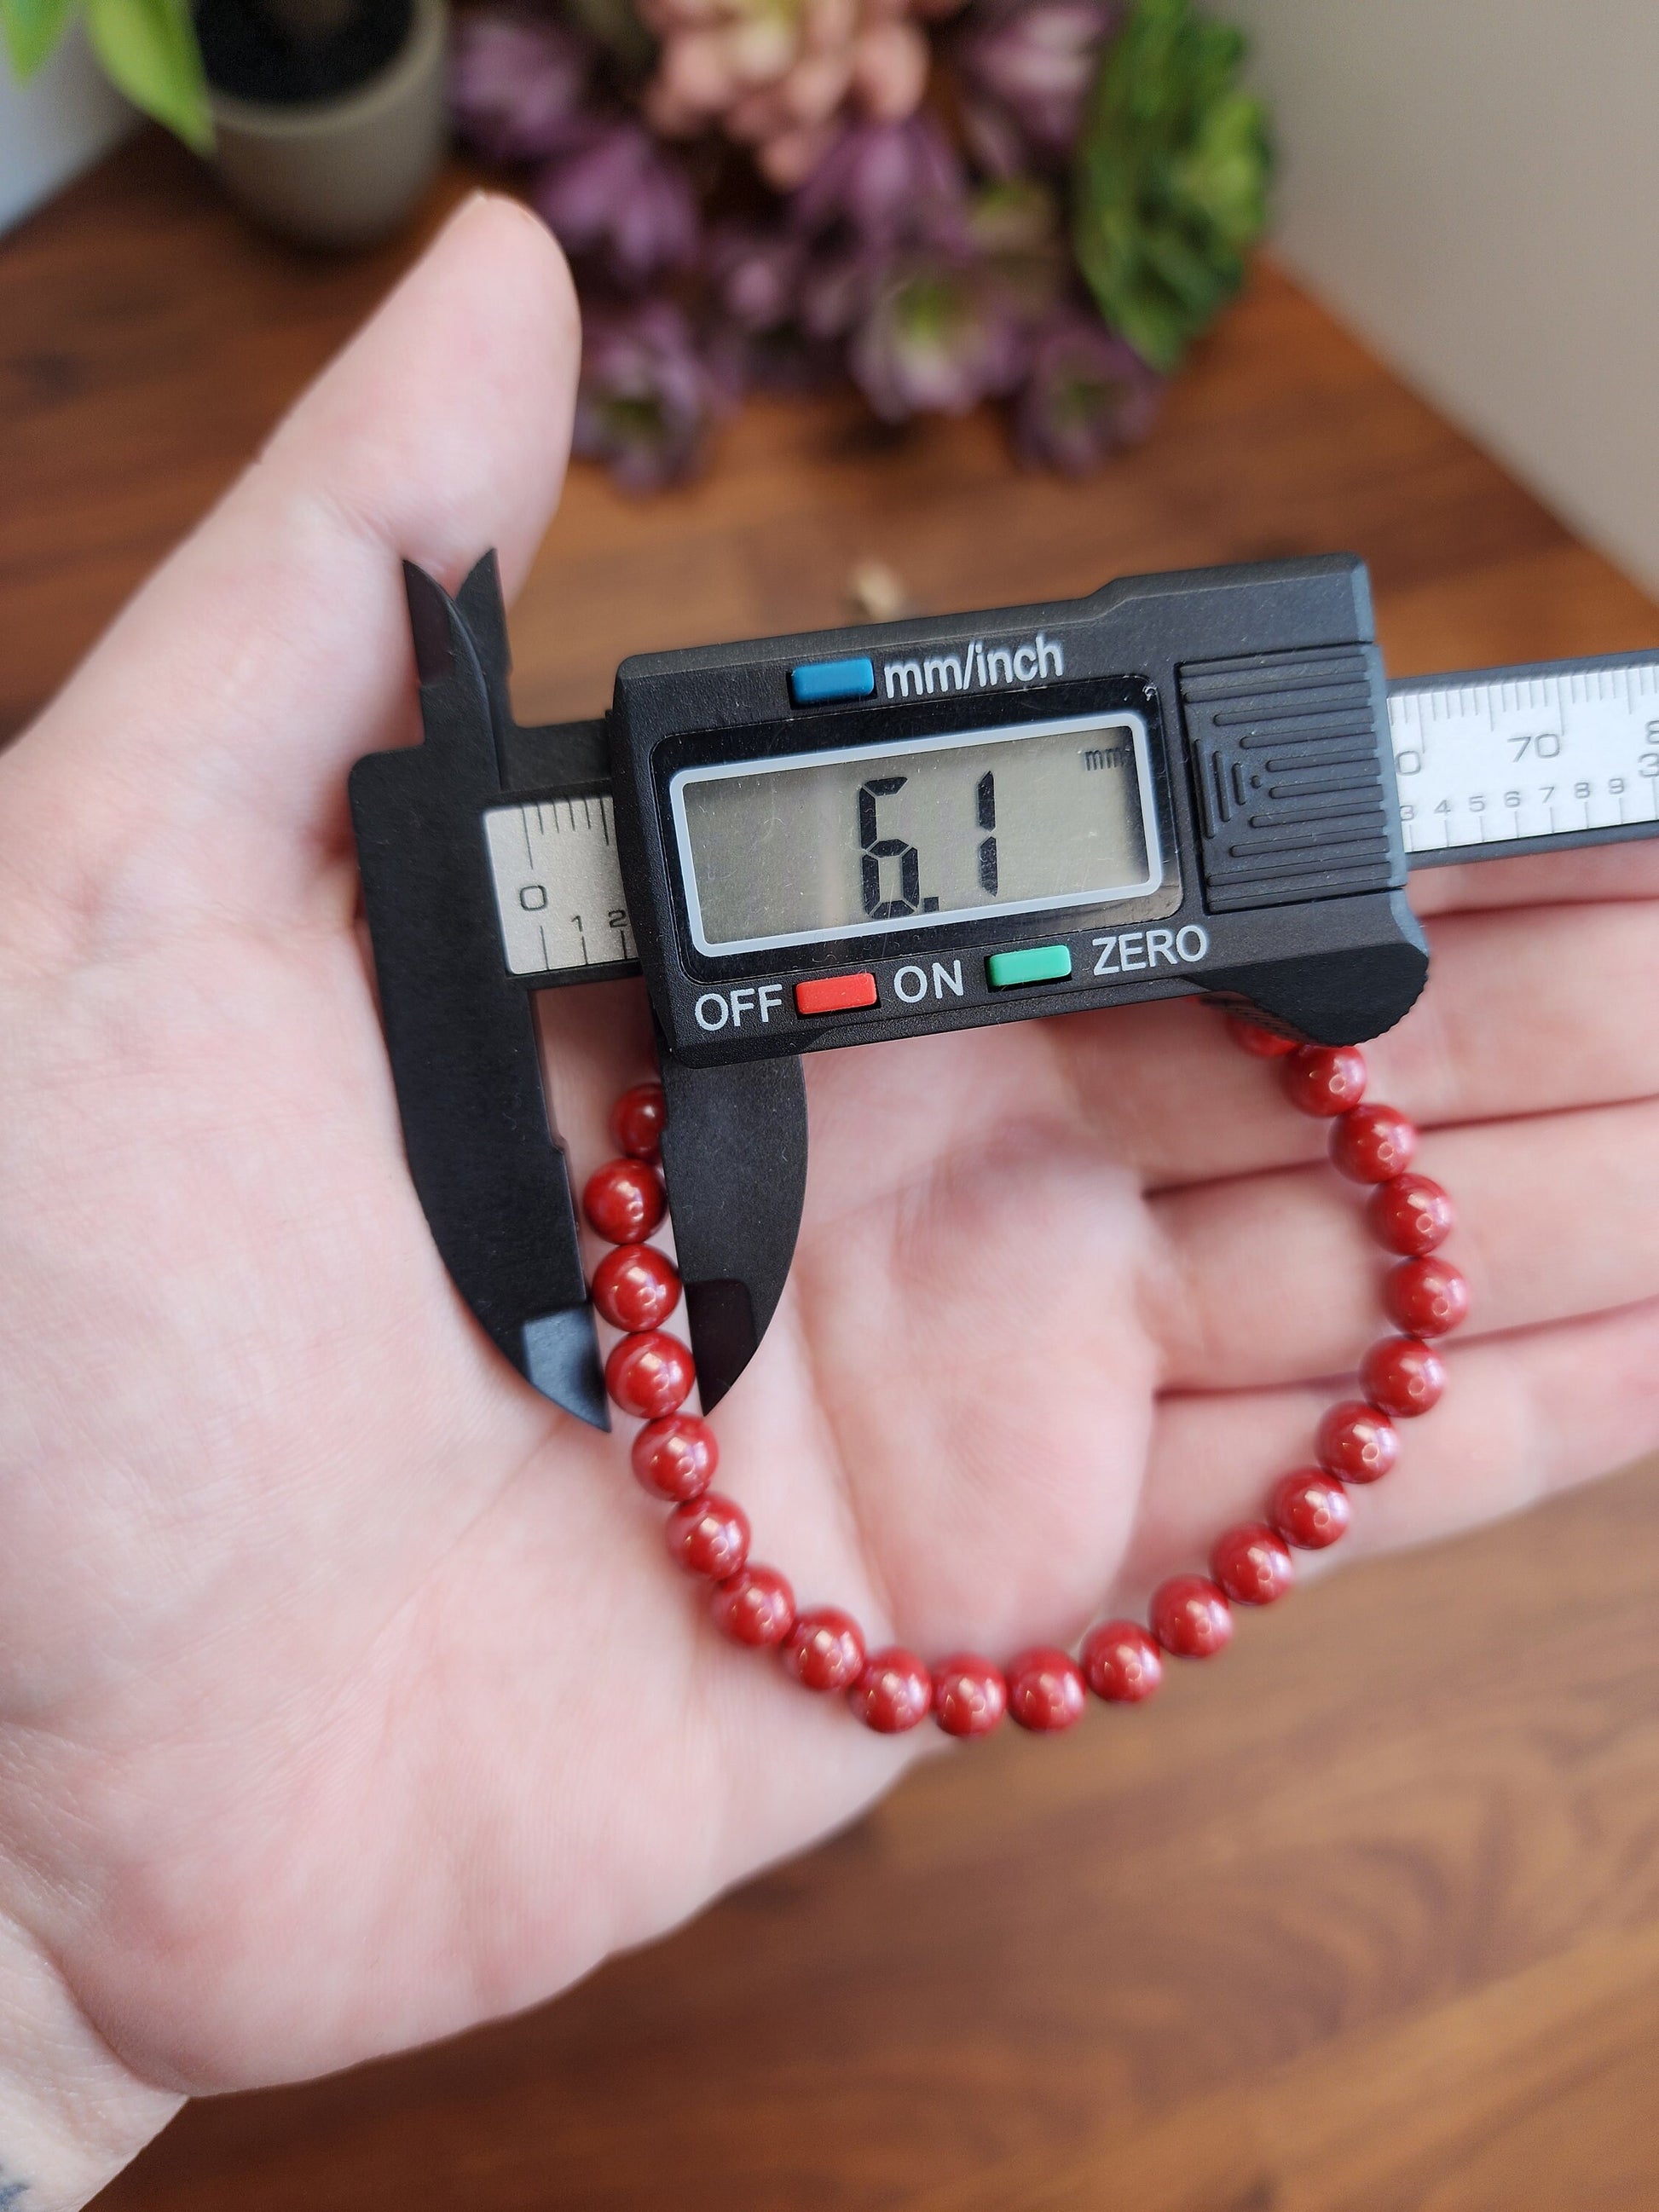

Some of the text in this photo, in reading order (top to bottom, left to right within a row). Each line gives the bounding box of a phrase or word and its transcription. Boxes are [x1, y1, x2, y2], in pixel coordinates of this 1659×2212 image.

[884, 633, 1063, 699] mm/inch
[1507, 734, 1560, 763] 70
[1434, 799, 1451, 815] 4
[1469, 795, 1486, 812] 5
[1504, 791, 1521, 808] 6
[1539, 786, 1555, 803] 7
[858, 771, 999, 920] 6.1
[571, 909, 628, 933] 1 2
[1091, 925, 1209, 976] ZERO
[893, 960, 965, 1004] ON
[695, 985, 783, 1031] OFF
